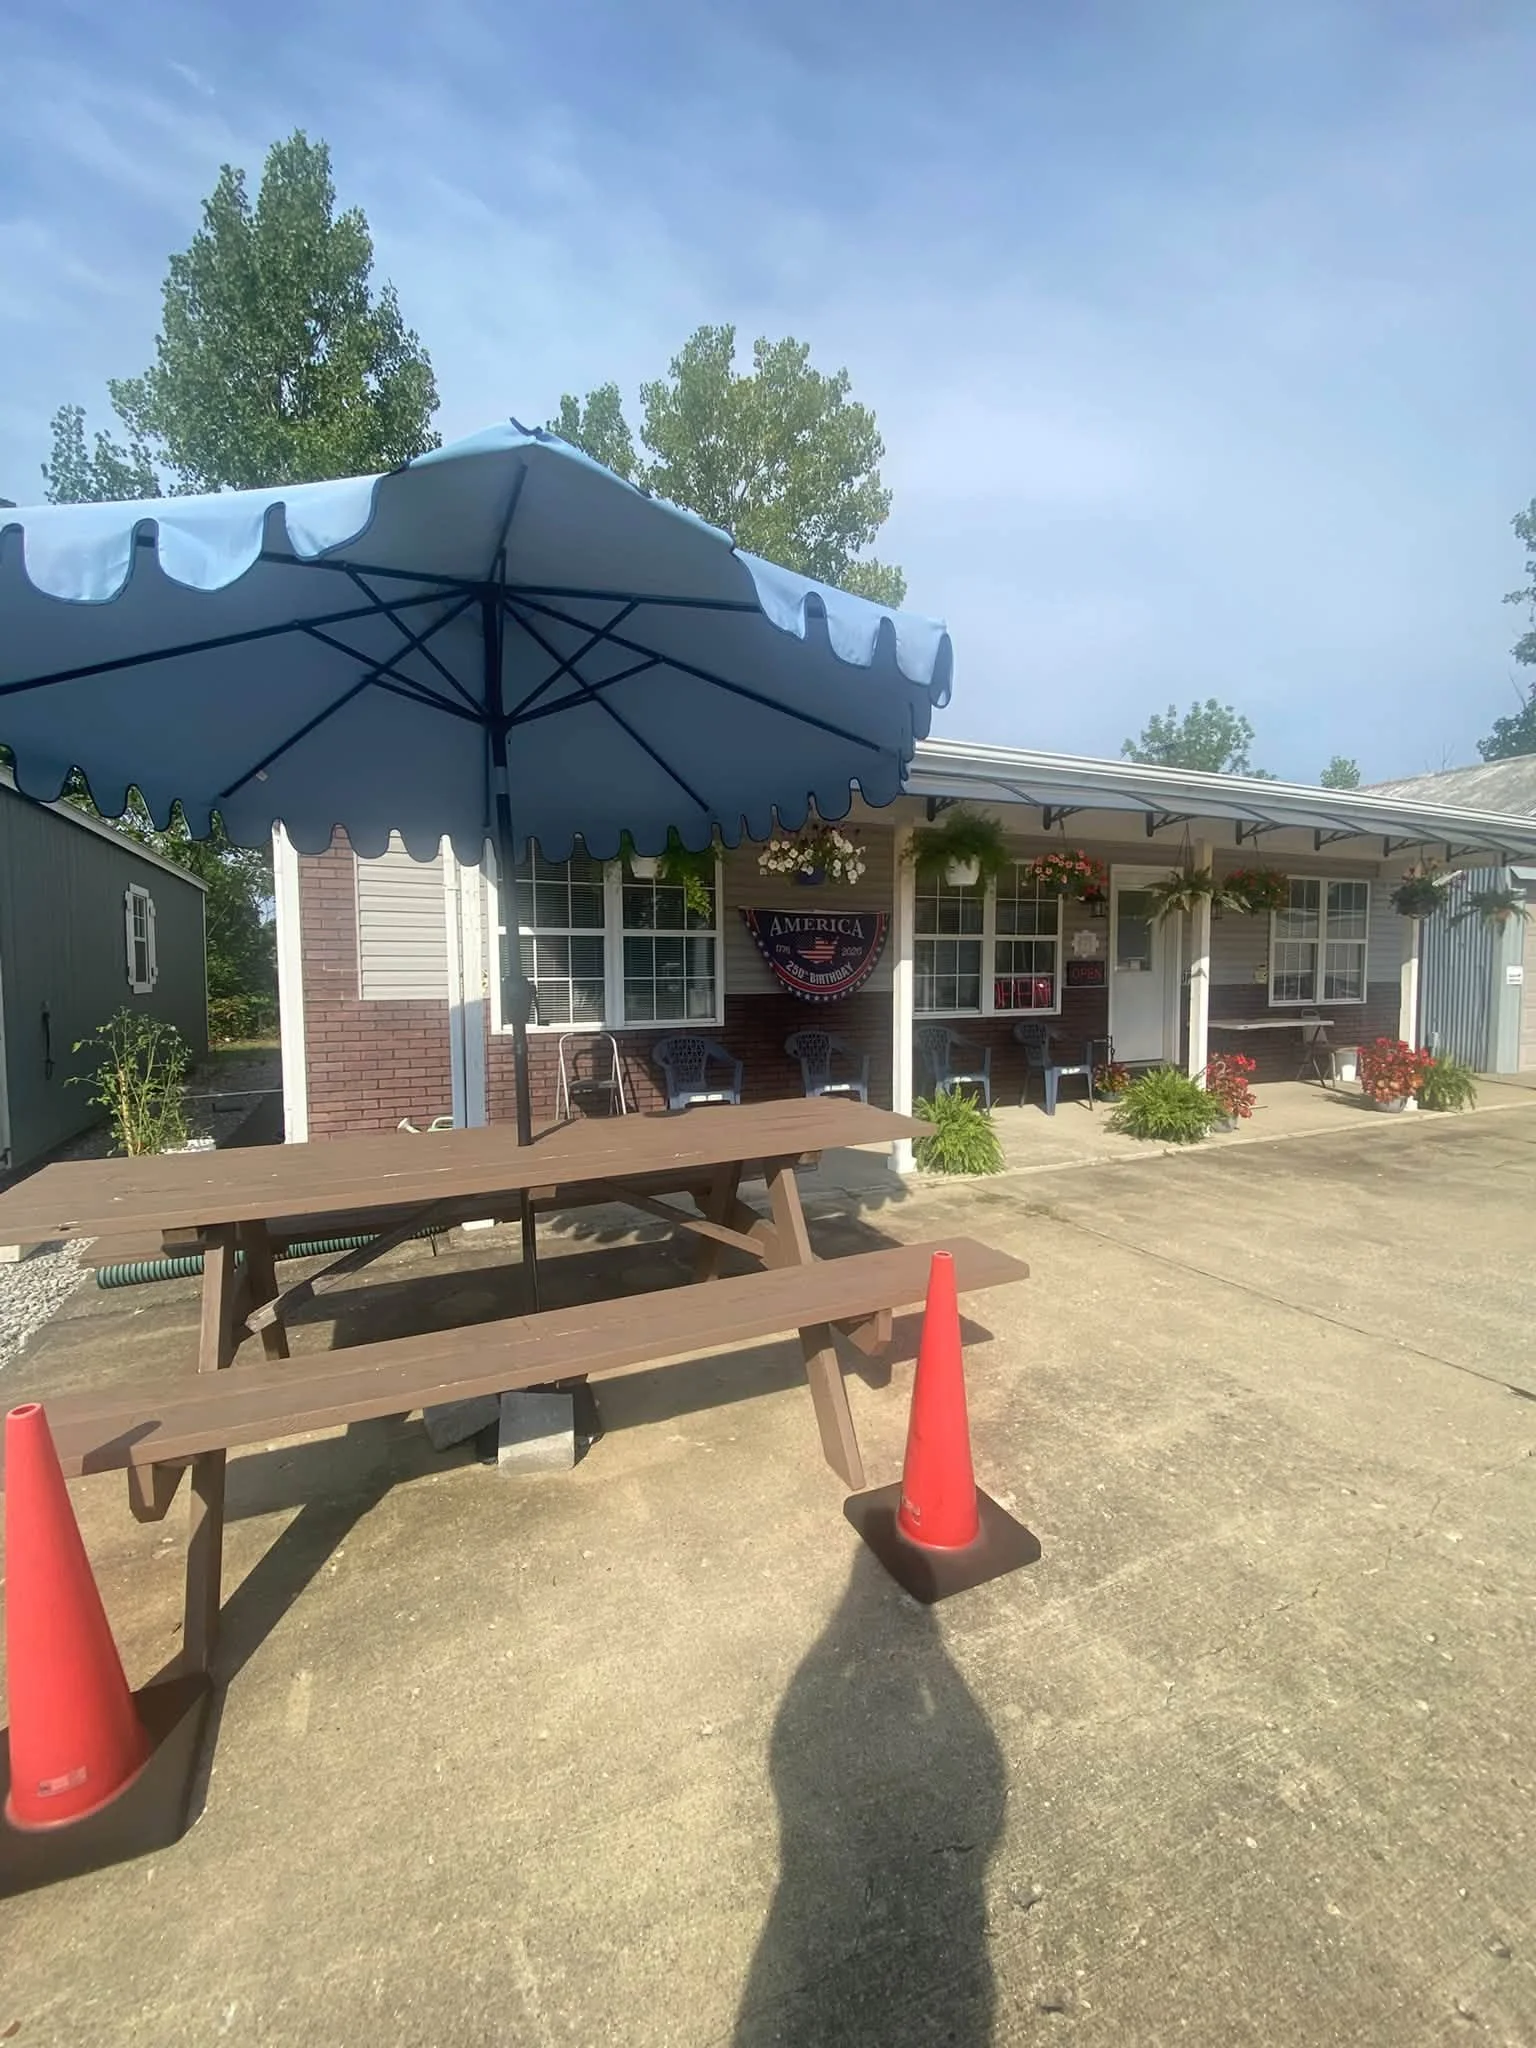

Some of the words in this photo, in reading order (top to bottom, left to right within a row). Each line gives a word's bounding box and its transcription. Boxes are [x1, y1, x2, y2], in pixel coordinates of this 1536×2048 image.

[770, 915, 864, 939] AMERICA
[809, 961, 854, 985] BIRTHDAY
[1072, 967, 1102, 980] OPEN
